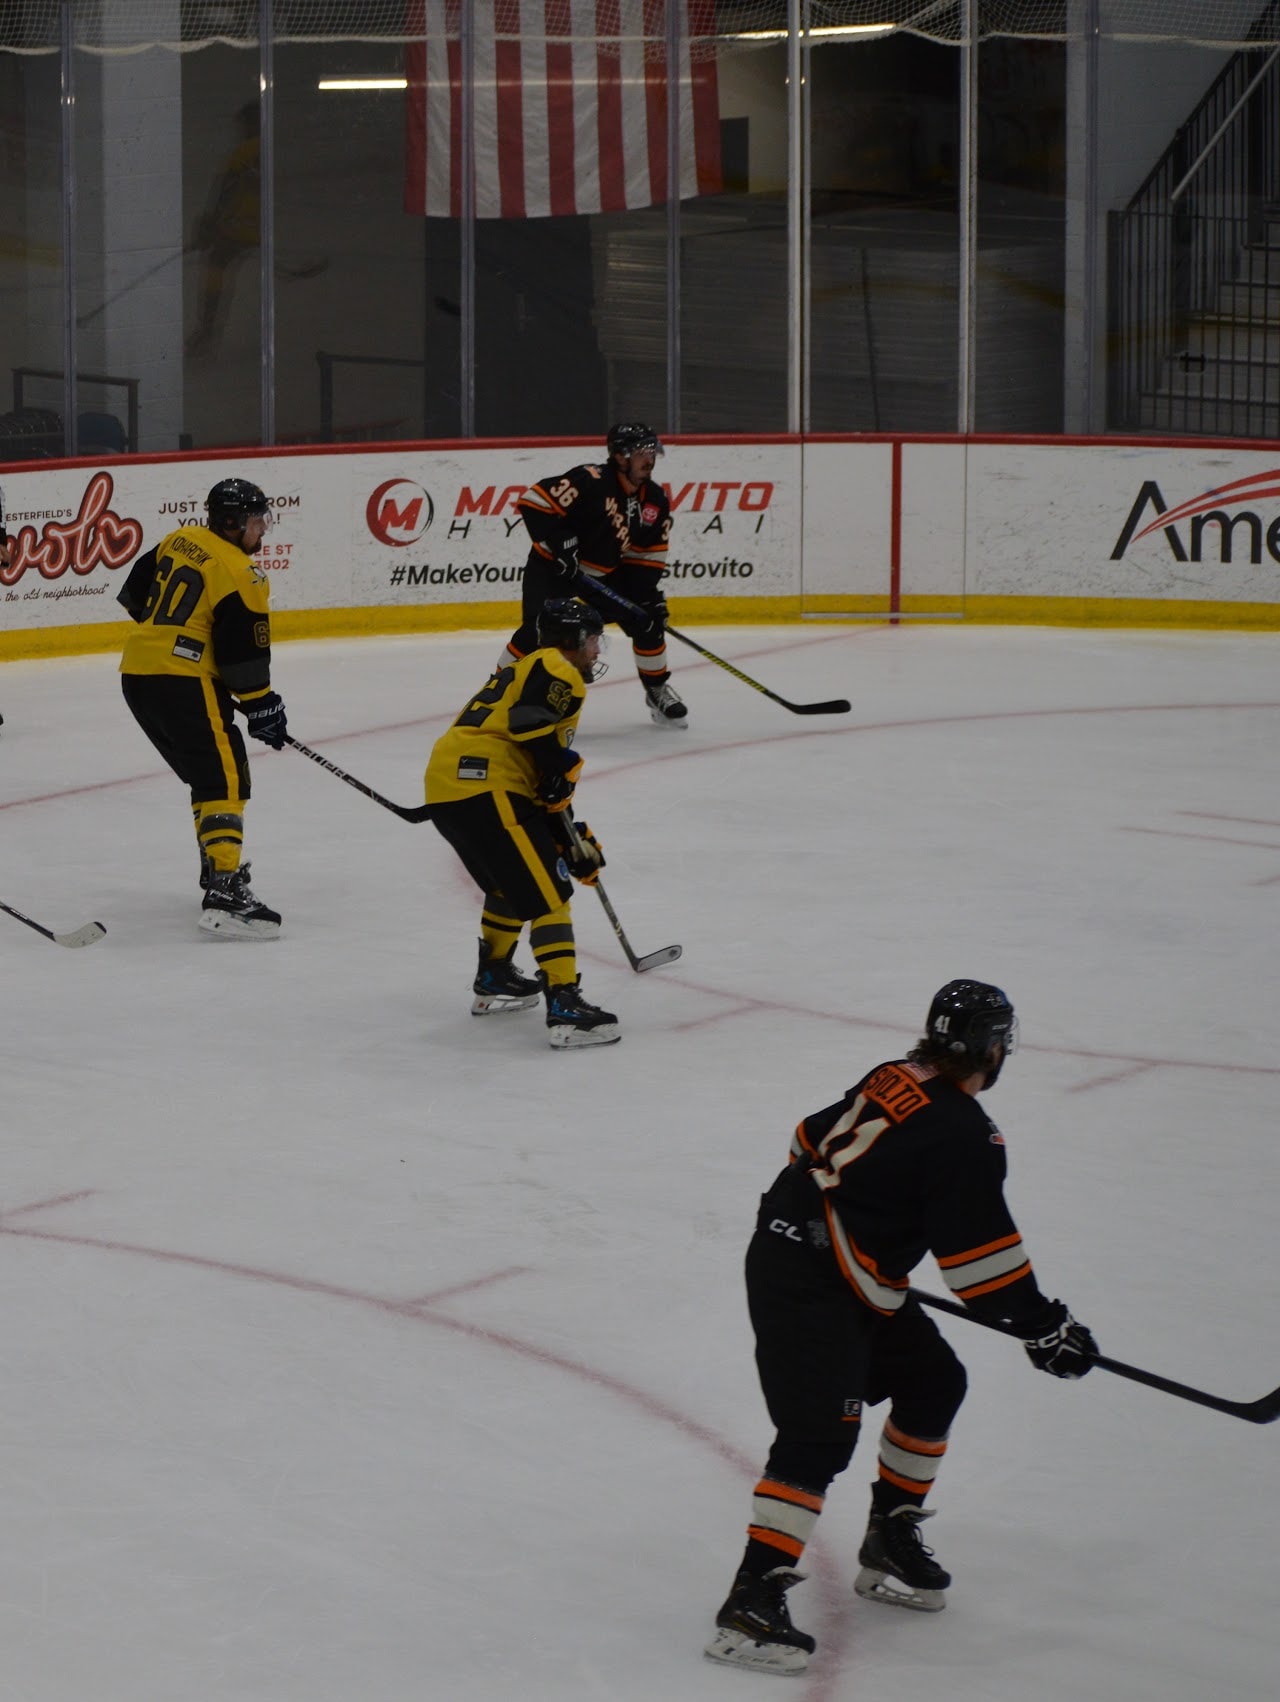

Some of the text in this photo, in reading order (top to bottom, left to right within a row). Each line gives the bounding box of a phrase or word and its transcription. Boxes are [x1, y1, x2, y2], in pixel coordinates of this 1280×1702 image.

[550, 478, 580, 508] 36
[158, 501, 198, 514] JUST
[266, 496, 300, 509] ROM
[177, 517, 210, 529] YOU
[275, 544, 294, 556] ST
[5, 589, 20, 601] the
[24, 587, 40, 601] old
[139, 556, 204, 626] 60
[934, 1014, 951, 1034] 41
